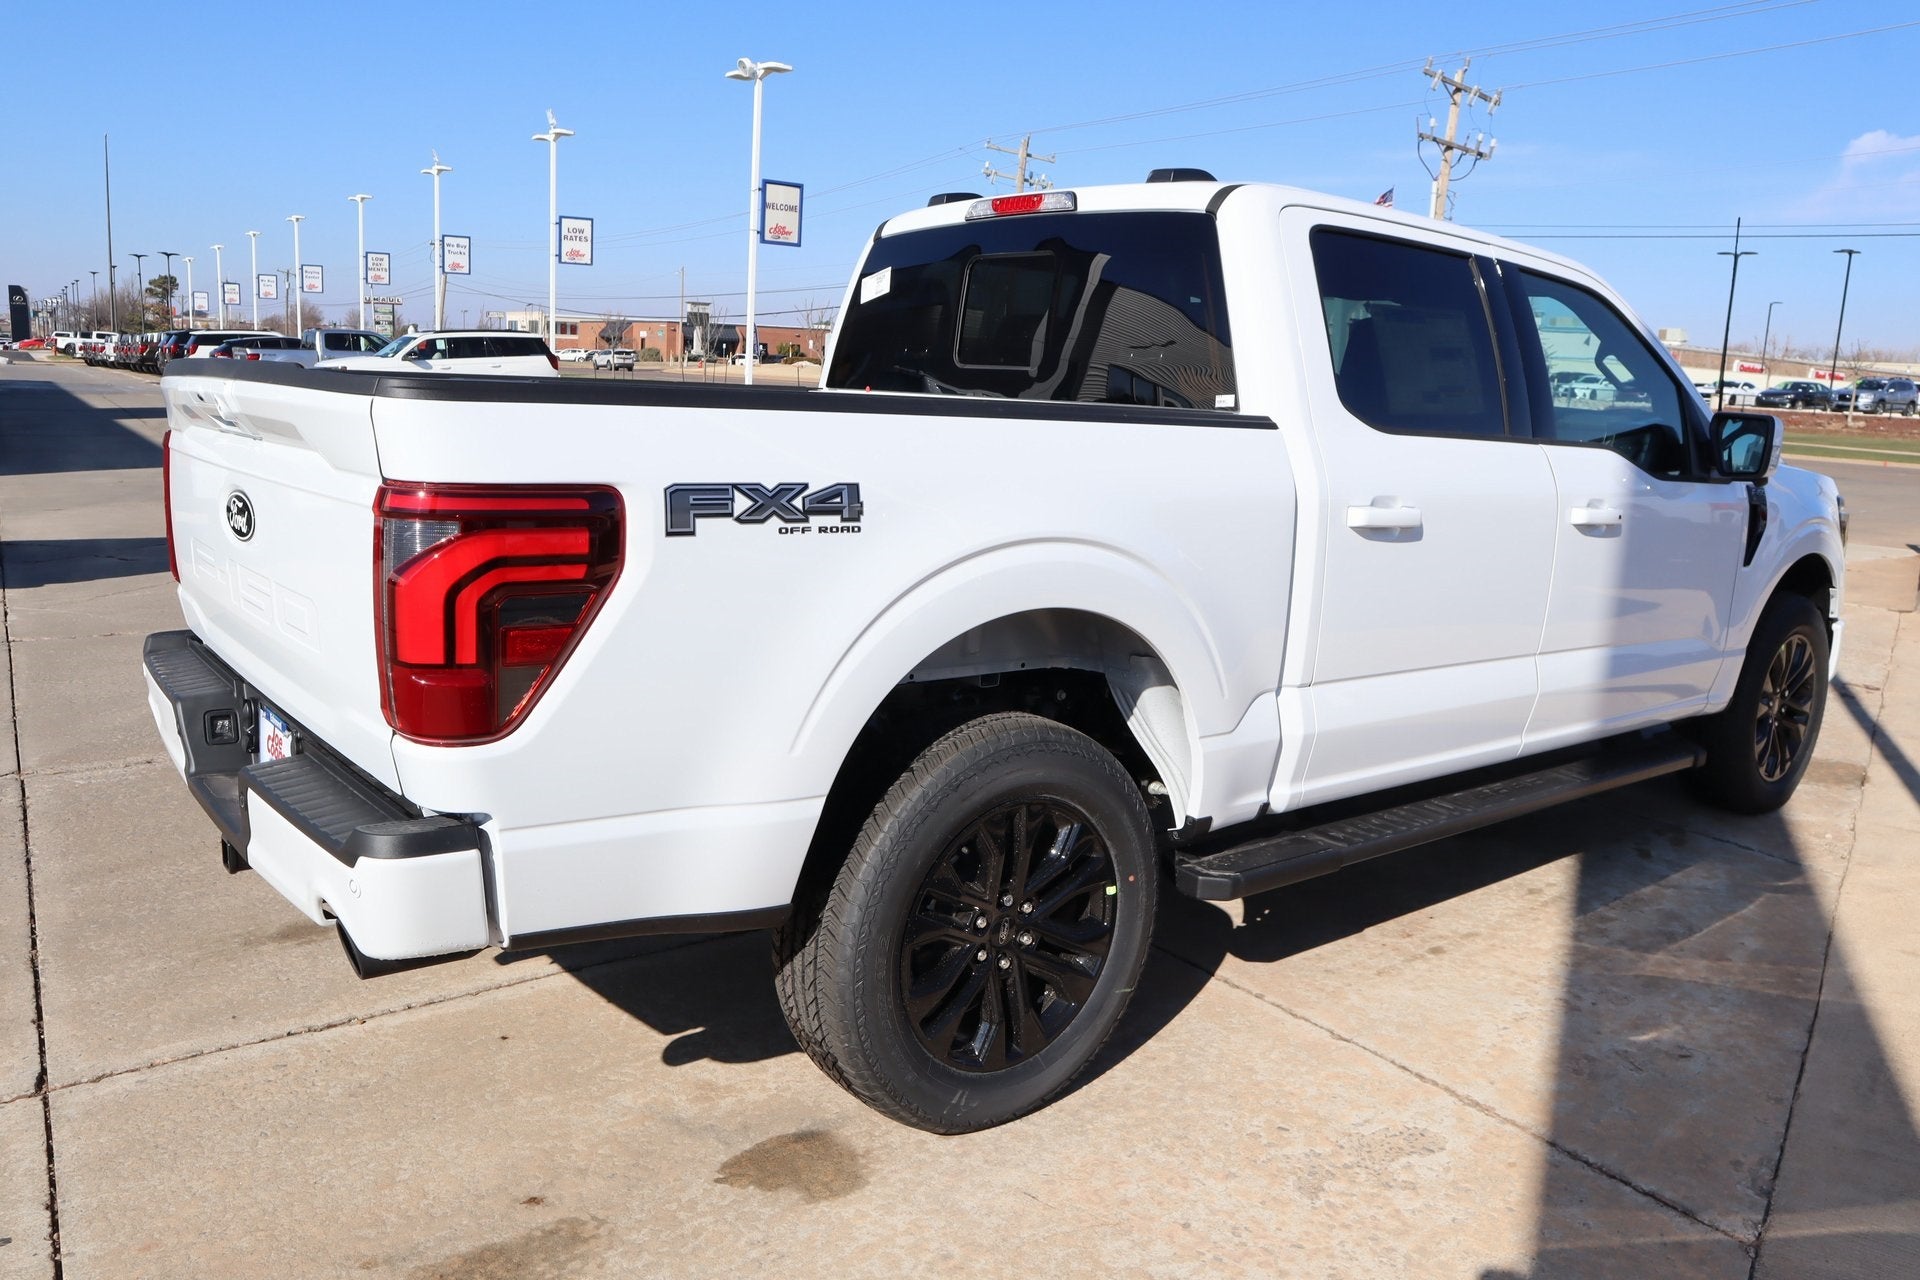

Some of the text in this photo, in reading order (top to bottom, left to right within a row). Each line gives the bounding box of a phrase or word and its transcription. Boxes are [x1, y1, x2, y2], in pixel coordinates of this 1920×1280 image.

[766, 202, 798, 213] WELCOME
[768, 227, 793, 237] Cooper
[775, 223, 787, 232] Joe
[563, 234, 589, 243] RATES
[664, 482, 864, 537] FX4
[778, 525, 862, 536] OFF ROAD
